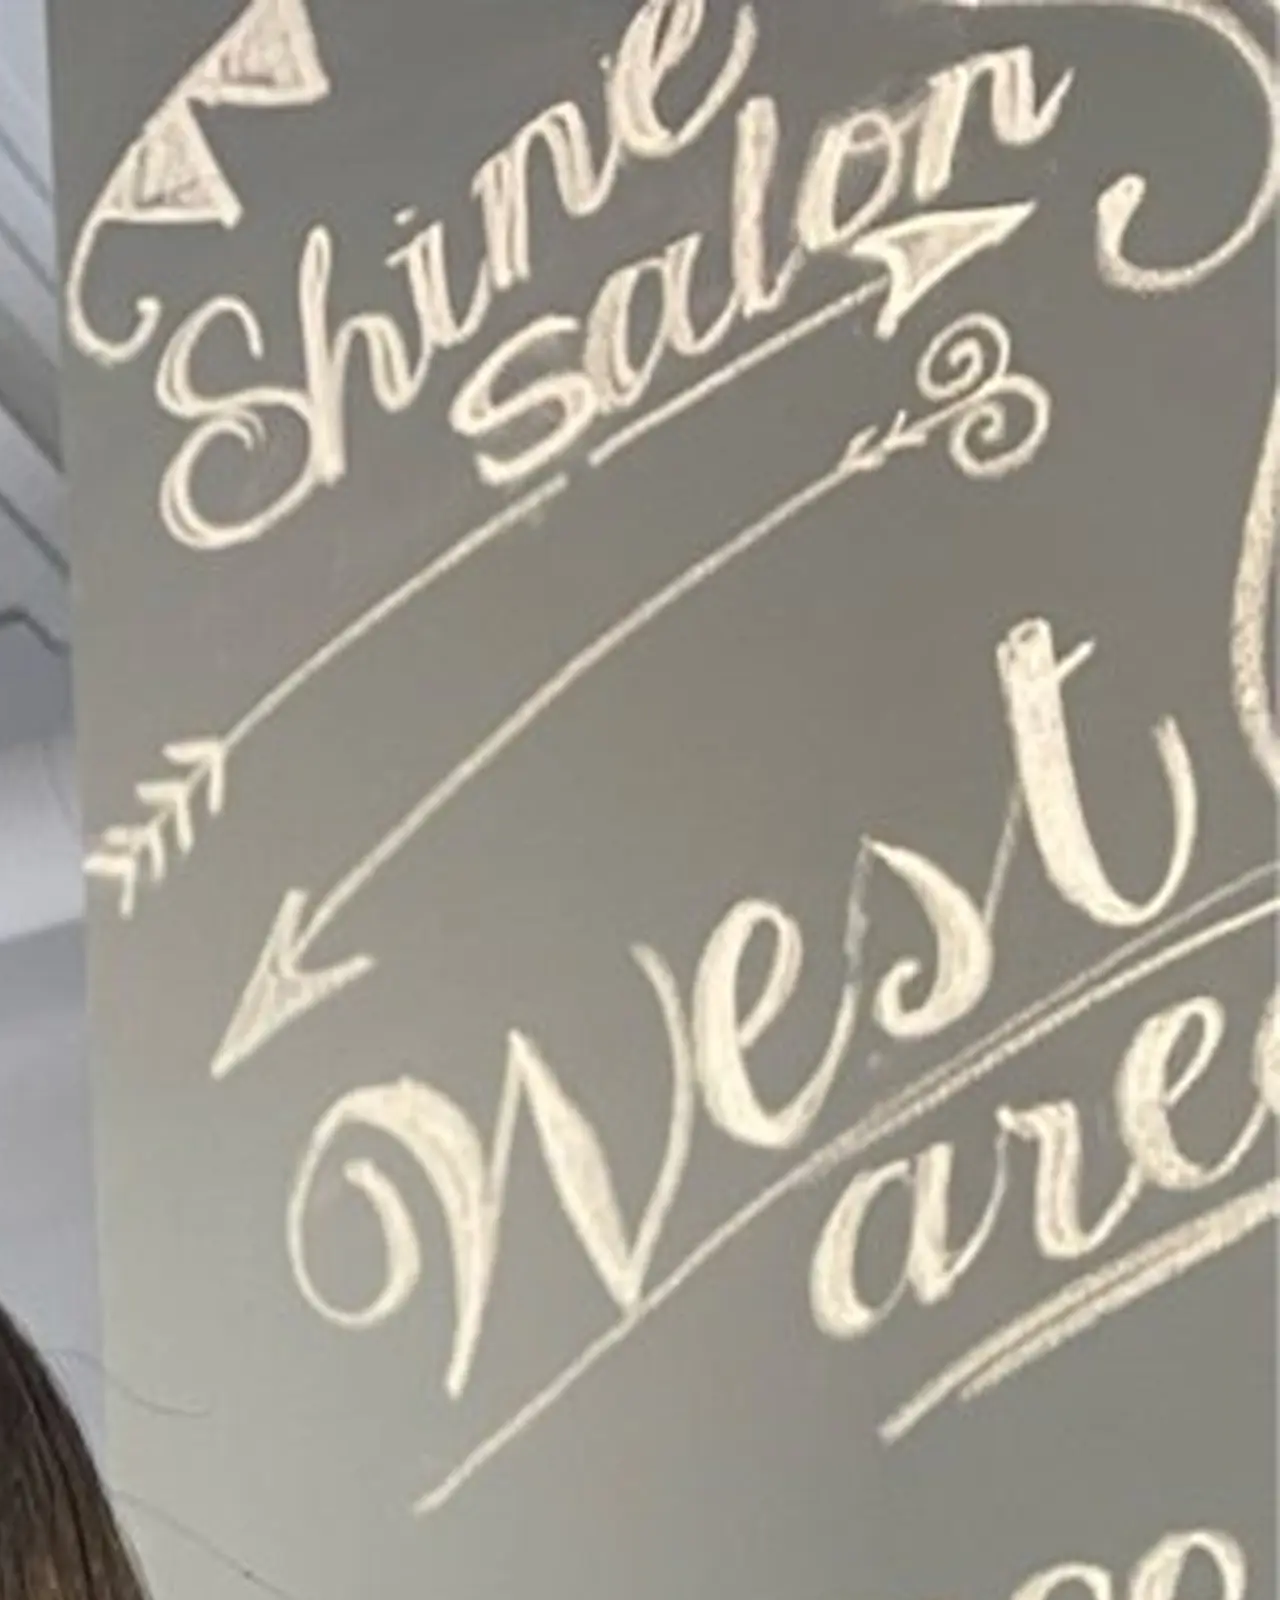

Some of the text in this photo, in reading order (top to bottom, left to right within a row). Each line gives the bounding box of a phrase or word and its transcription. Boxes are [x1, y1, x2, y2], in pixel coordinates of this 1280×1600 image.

[154, 0, 759, 550] Shine
[287, 617, 1200, 1400] West
[808, 975, 1280, 1341] are
